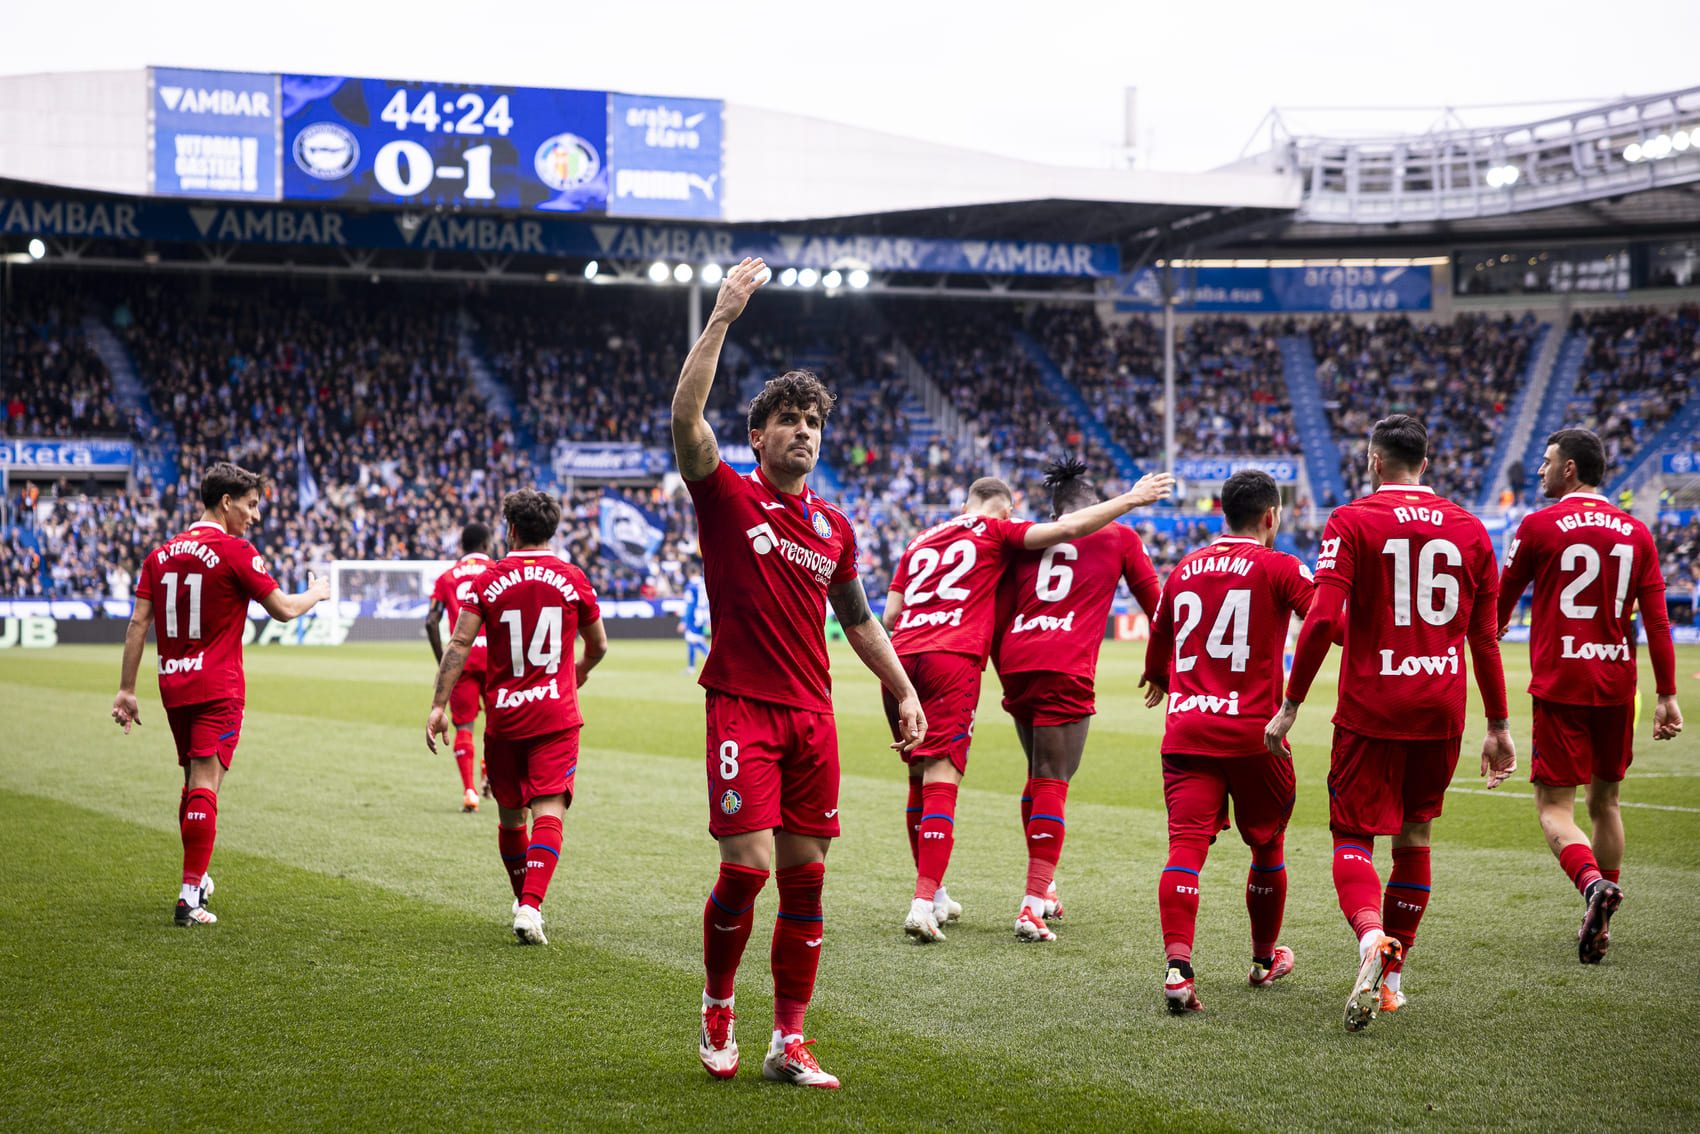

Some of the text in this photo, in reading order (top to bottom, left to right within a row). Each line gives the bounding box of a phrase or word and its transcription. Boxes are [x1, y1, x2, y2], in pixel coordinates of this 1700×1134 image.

[180, 89, 271, 118] AMBAR
[381, 89, 514, 136] 44:24
[374, 140, 496, 200] 0-1
[4, 202, 140, 237] AMBAR
[218, 211, 347, 244] AMBAR
[422, 219, 544, 251] AMBAR
[614, 226, 734, 257] AMBAR
[801, 237, 917, 267] AMBAR
[984, 244, 1096, 275] AMBAR
[1393, 506, 1444, 526] RICO
[1555, 511, 1634, 536] IGLESIAS
[482, 565, 580, 603] JUAN BERNAT
[903, 538, 978, 607] 22
[1035, 542, 1079, 603] 6
[1180, 556, 1254, 581] JUANMI
[1381, 538, 1463, 627] 16
[1559, 543, 1634, 620] 21
[160, 571, 203, 639] 11
[900, 607, 964, 630] Lowi
[1011, 610, 1076, 635] Lowi
[1173, 588, 1251, 673] 24
[499, 605, 563, 678] 14
[1560, 635, 1631, 662] Lowi
[157, 651, 205, 676] Lowi
[1378, 646, 1460, 677] Lowi
[495, 678, 561, 709] Lowi
[1167, 690, 1240, 716] Lowi
[719, 739, 740, 781] 8
